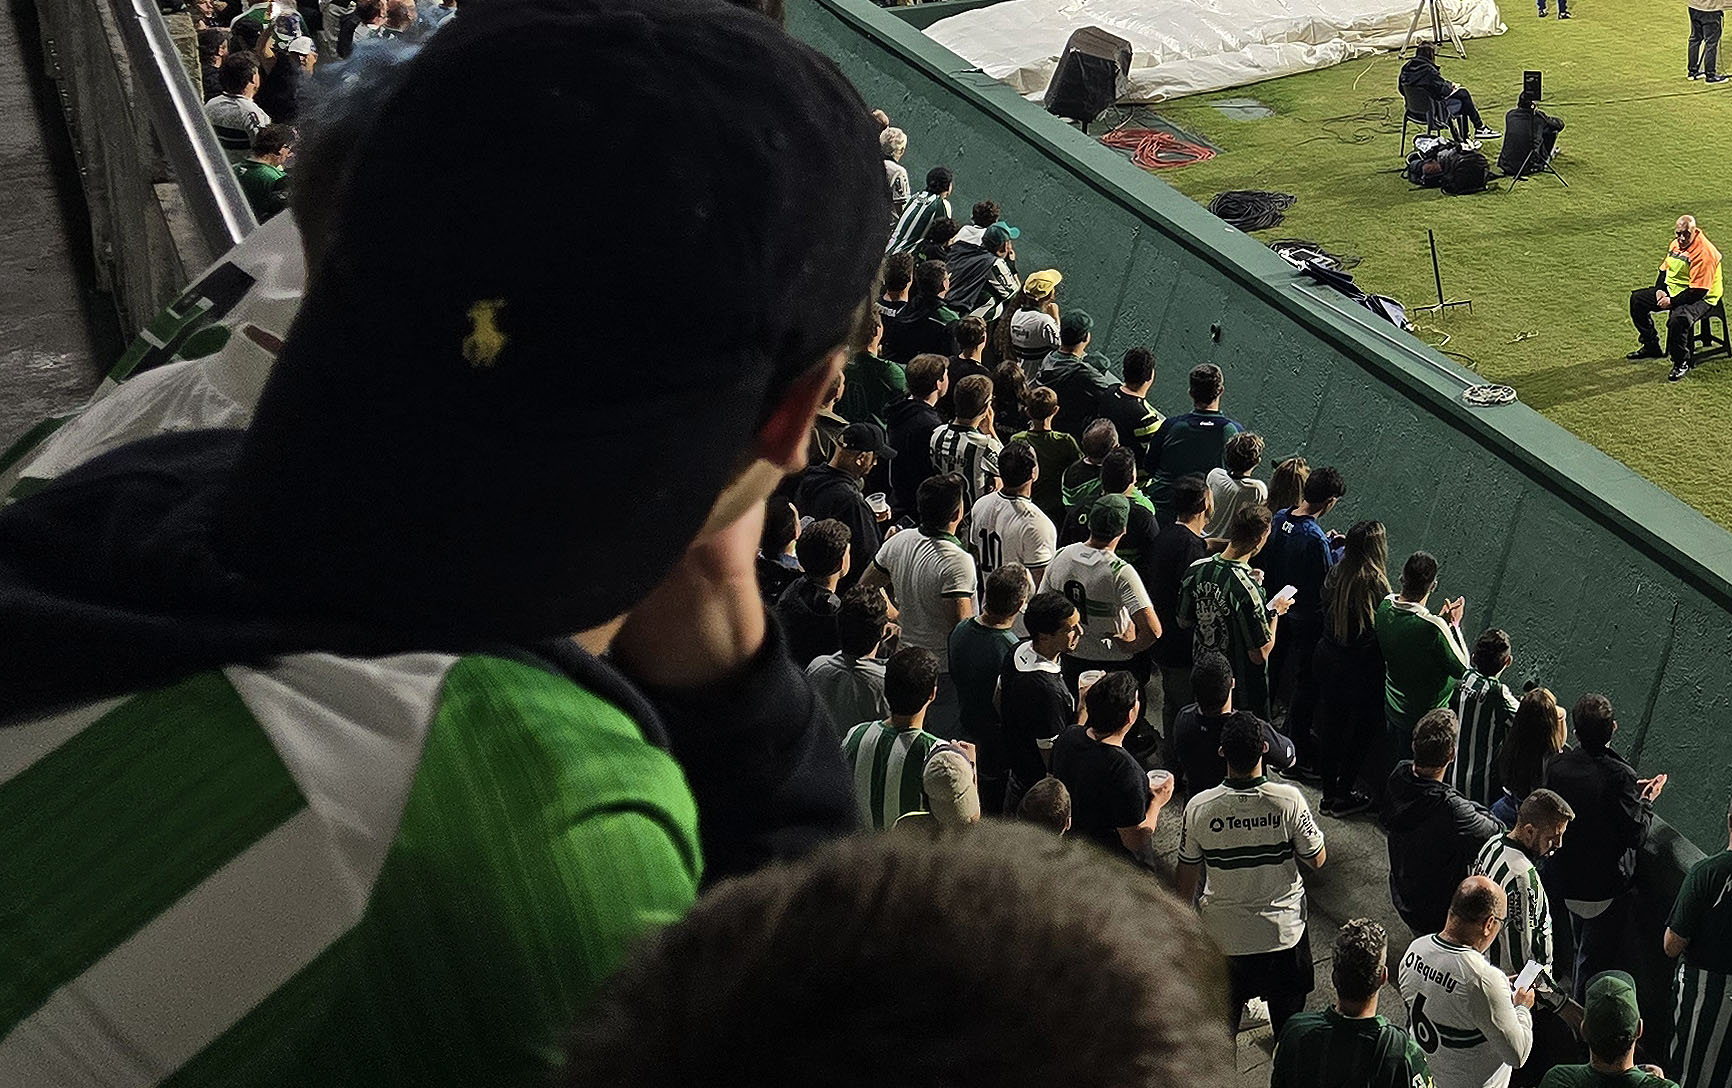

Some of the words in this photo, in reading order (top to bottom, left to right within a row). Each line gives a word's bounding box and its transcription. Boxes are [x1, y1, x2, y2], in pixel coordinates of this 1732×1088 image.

[978, 527, 1003, 573] 10
[1226, 812, 1281, 831] Tequaly
[1413, 954, 1458, 994] Tequaly
[1411, 991, 1439, 1055] 6
